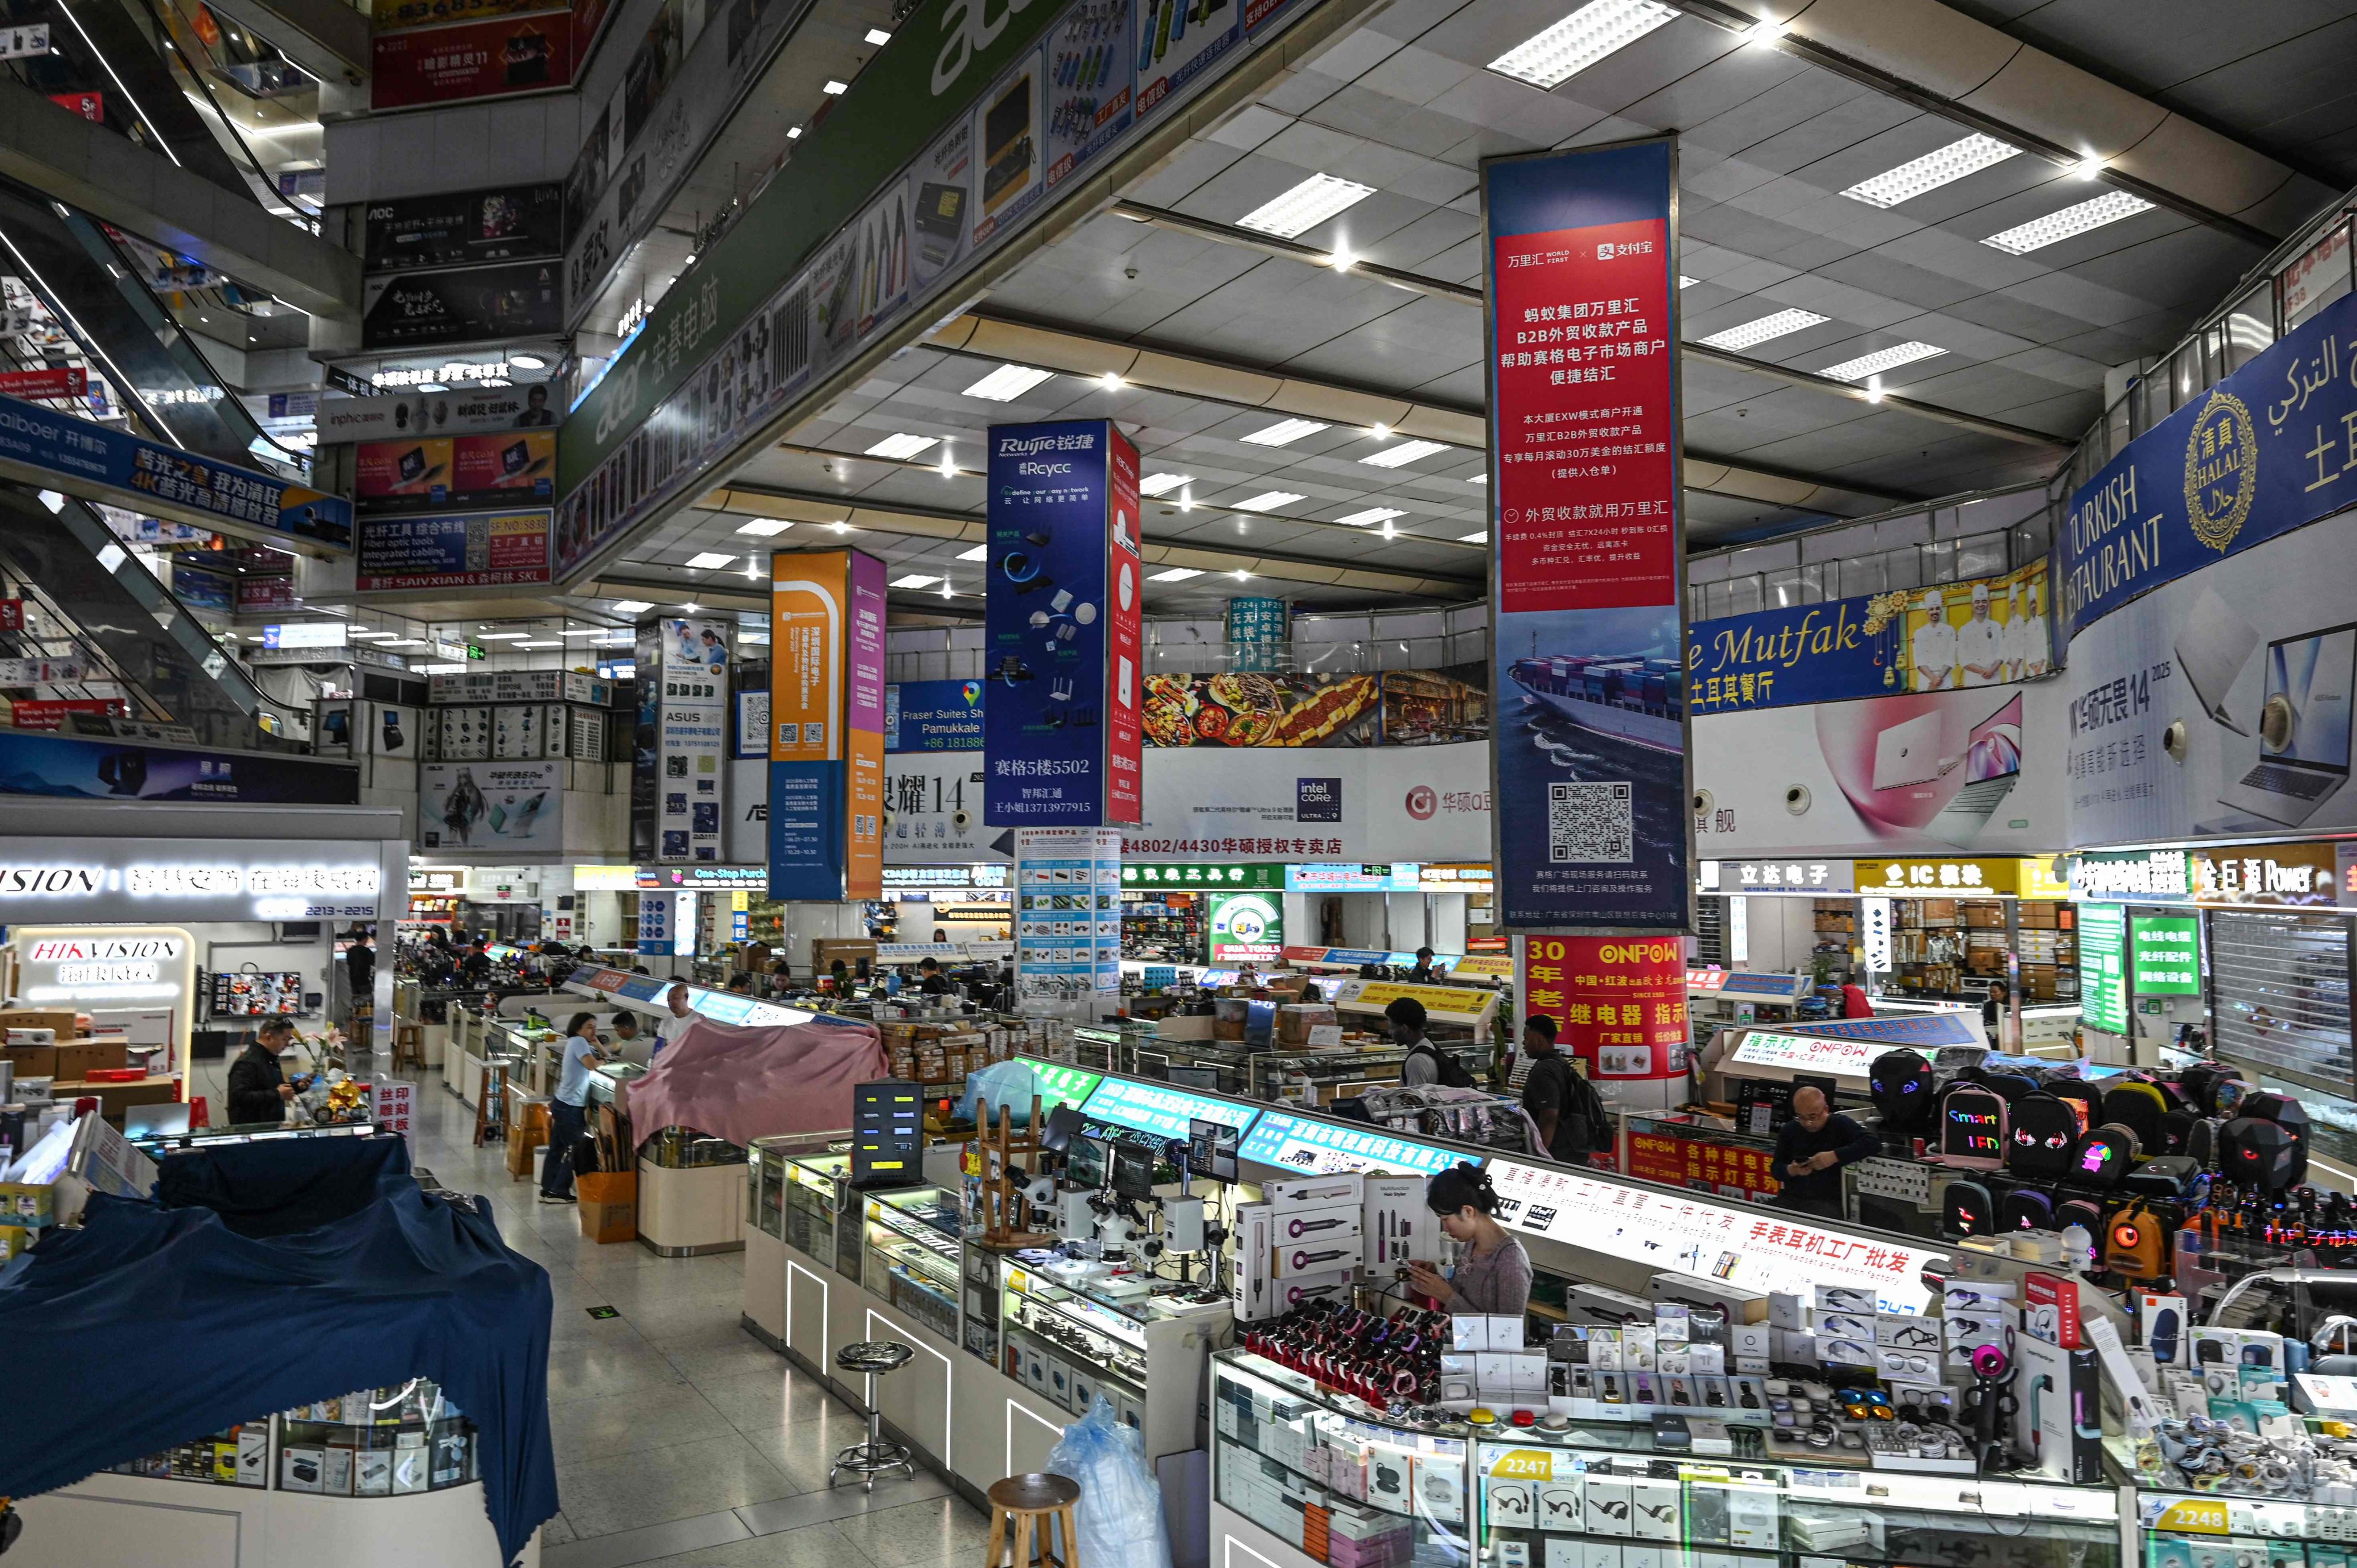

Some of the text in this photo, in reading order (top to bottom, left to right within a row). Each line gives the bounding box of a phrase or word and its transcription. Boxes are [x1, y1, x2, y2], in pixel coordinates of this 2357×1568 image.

[1137, 80, 1166, 113] 电信级
[1096, 91, 1128, 125] 工厂直发
[1048, 157, 1072, 184] 电信级
[368, 207, 394, 220] AOC
[1616, 241, 1652, 256] 支付宝
[1508, 253, 1544, 268] 万里汇
[1524, 297, 1639, 323] 蚂蚁集团万里汇
[1517, 319, 1647, 344] B2B外贸收款产品
[1501, 339, 1665, 368] 帮助赛格电子市场商户
[1550, 365, 1616, 386] 便捷结汇
[1524, 406, 1643, 424] 本大厦EXW模式商户开通
[1525, 425, 1642, 443] 万里汇B2B外贸收款产品
[2201, 415, 2233, 459] 清真
[1000, 434, 1095, 455] Ruijie 锐捷
[1503, 442, 1666, 463] 专享每月滚动30万美金的结汇额度
[2197, 448, 2241, 490] HALAL
[1525, 500, 1668, 523] 外贸收款就用万里汇
[2070, 464, 2138, 561] TURKISH
[365, 521, 464, 537] 光纤工具 综合布线
[1505, 533, 1528, 541] 手续费
[1529, 531, 1564, 540] 0.4%封顶
[1621, 526, 1645, 535] 秒到账
[1647, 525, 1667, 533] 0汇损
[363, 537, 433, 548] Fiber optic tools
[363, 547, 445, 560] Integrated cabling
[1232, 601, 1283, 610] 3F24 3F25
[1711, 603, 1862, 674] Mutfak
[2152, 661, 2171, 684] 2025
[1690, 671, 1775, 706] 土耳其餐厅
[666, 713, 700, 722] ASUS
[903, 709, 967, 720] Fraser Suites
[922, 723, 980, 734] Pamukkale
[924, 737, 985, 748] +86 181886
[994, 759, 1090, 776] 赛格5楼5502
[1021, 787, 1063, 798] 智邦汇通
[1301, 783, 1327, 793] intel
[994, 802, 1090, 813] 王小姐13713977915
[695, 868, 767, 880] One-Stop Purch
[1536, 869, 1648, 880] 赛格广场现场服务请扫码联系
[1739, 864, 1829, 885] 立达电子
[1912, 864, 1983, 885] IC 模块
[2265, 860, 2312, 892] Power
[1532, 884, 1653, 894] 我们将提供上门咨询及操作服务
[304, 906, 374, 916] 2213-2215
[2138, 930, 2192, 943] 电线电缆
[33, 941, 175, 959] HIKVISION
[1248, 944, 1282, 953] TOOLS
[1599, 943, 1677, 963] ONPOW
[2138, 951, 2192, 963] 光纤配件
[2139, 971, 2192, 983] 网络设备
[1570, 1004, 1642, 1025] 继电器
[1599, 1032, 1643, 1043] 厂家直销
[1748, 1034, 1869, 1057] 指示灯 ONPOW
[1949, 1109, 1998, 1124] Smart
[1635, 1138, 1676, 1155] ONPOW
[1687, 1162, 1779, 1192] 指示灯系列
[1660, 1203, 1735, 1230] 一件代发
[1700, 1230, 1727, 1243] Sales
[1750, 1222, 1911, 1274] 手表耳机工厂批发
[1506, 1458, 1547, 1474] 2247
[2167, 1501, 2215, 1520] 2248
